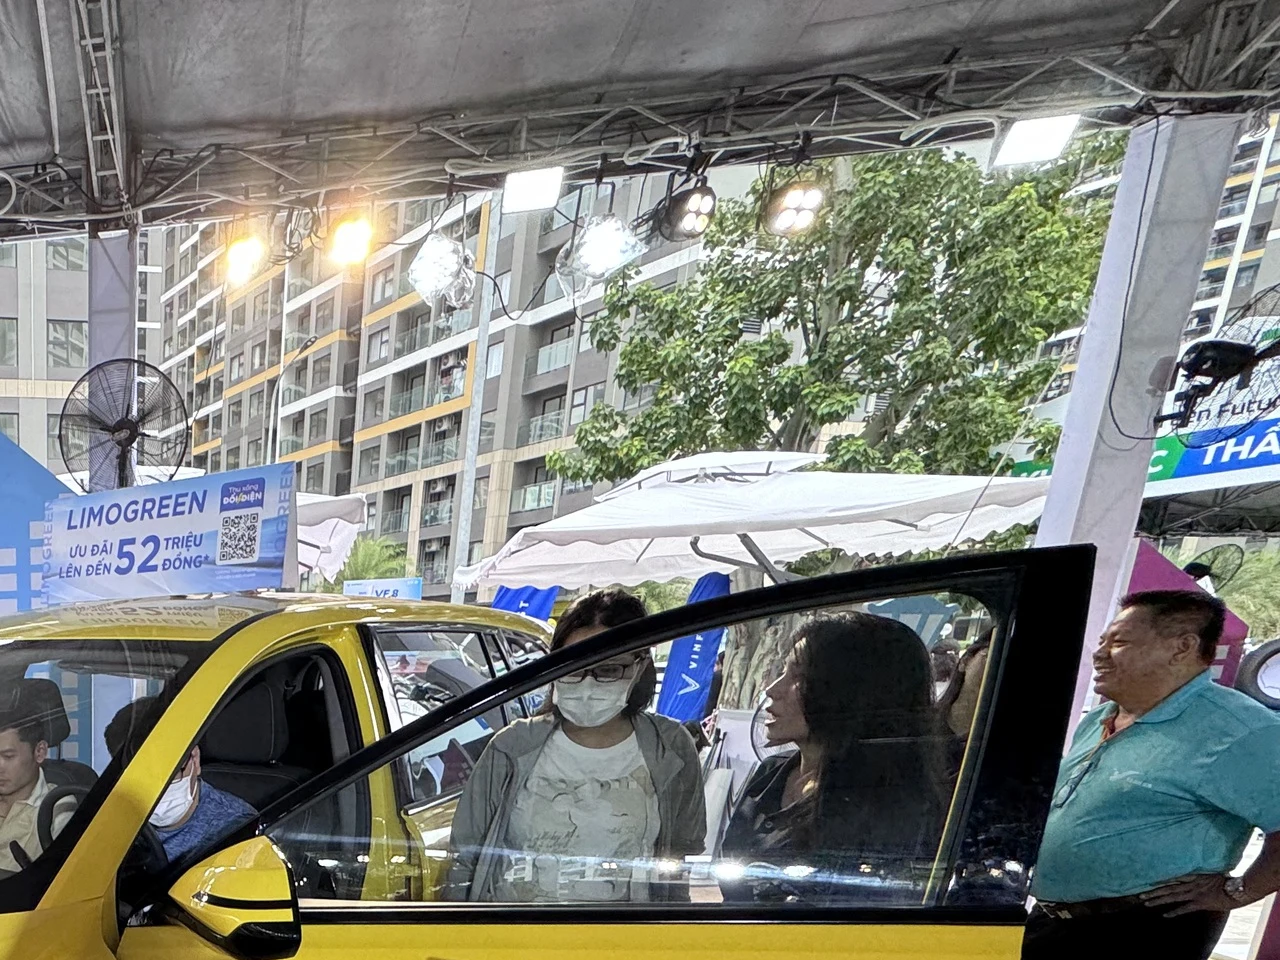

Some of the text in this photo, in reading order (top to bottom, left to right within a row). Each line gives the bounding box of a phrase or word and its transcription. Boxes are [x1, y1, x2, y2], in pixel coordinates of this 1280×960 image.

[66, 489, 208, 531] LIMOGREEN
[69, 539, 113, 558] ƯU ĐÃI
[114, 534, 161, 576] 52
[163, 531, 204, 552] TRIỆU
[58, 557, 112, 579] LÊN ĐẾN
[689, 634, 704, 669] VINF
